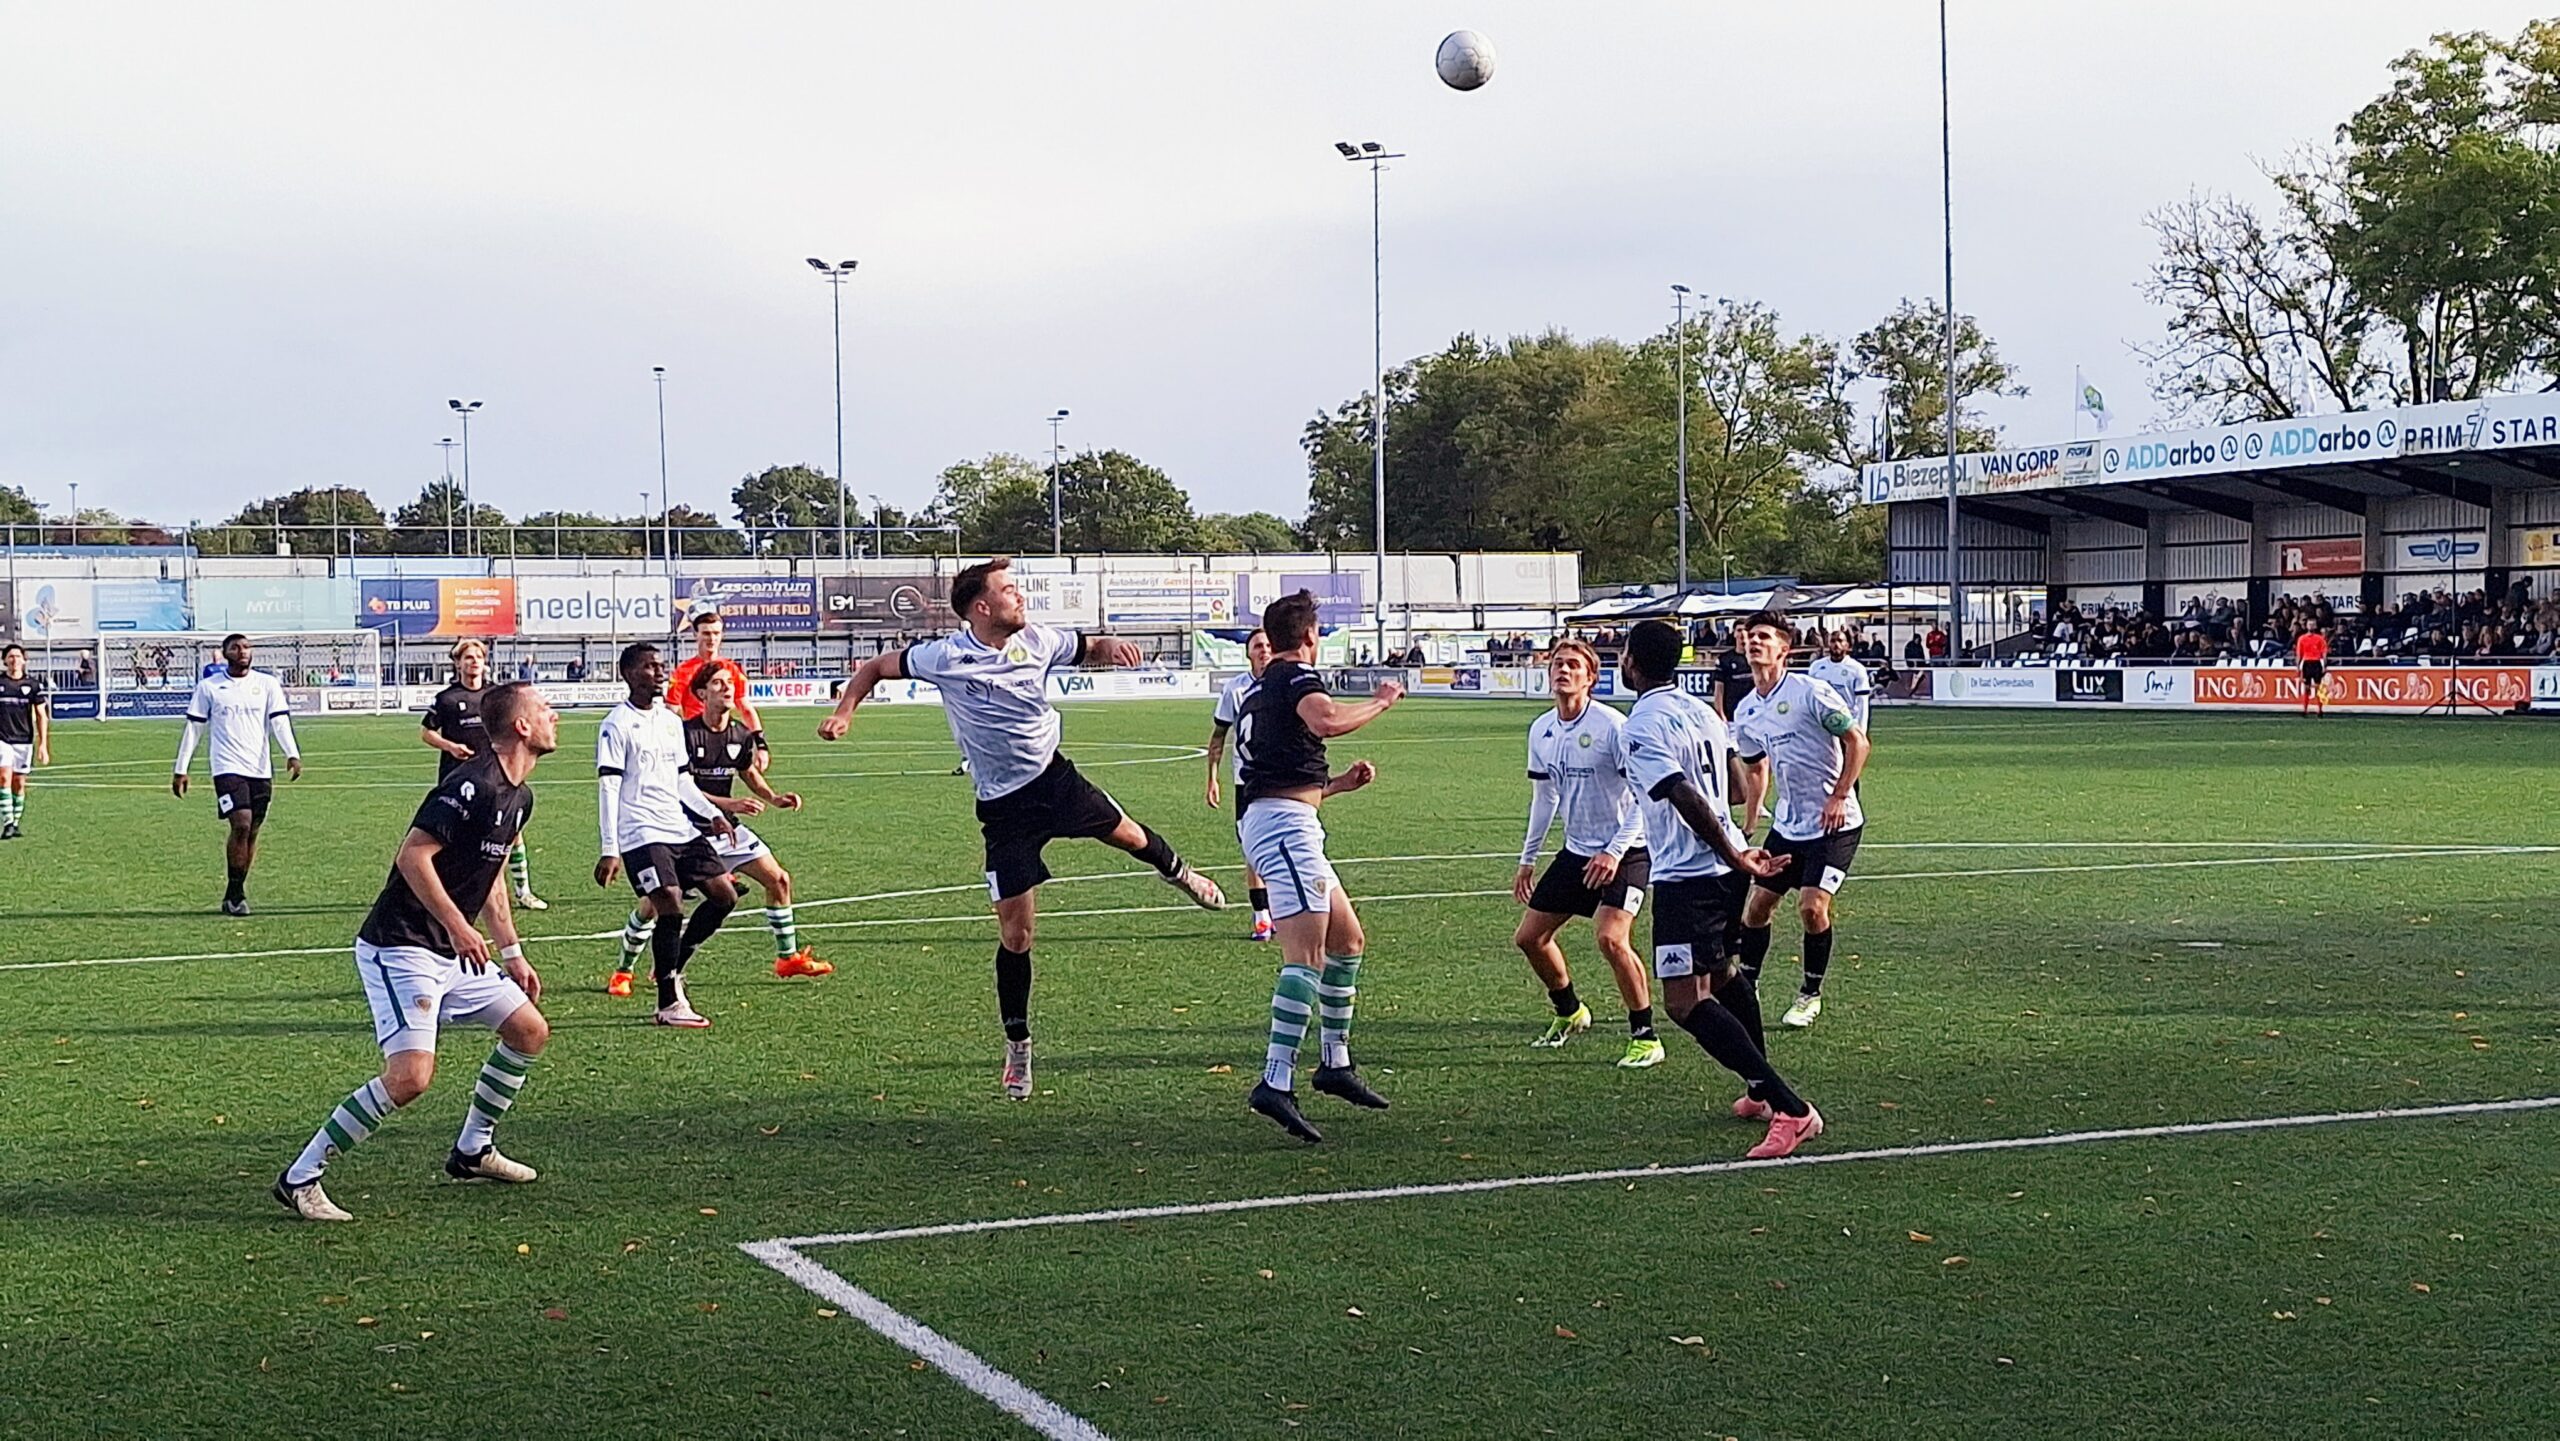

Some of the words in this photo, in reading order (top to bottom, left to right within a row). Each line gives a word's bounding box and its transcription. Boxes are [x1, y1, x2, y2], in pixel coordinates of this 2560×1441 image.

[2269, 424, 2371, 457] ADDarbo
[2404, 424, 2463, 452] PRIM
[1980, 453, 2013, 475] VAN
[2015, 448, 2060, 472] GORP
[2125, 439, 2216, 471] ADDarbo
[526, 590, 665, 619] neelevat
[1056, 675, 1094, 695] VSM
[2071, 670, 2106, 693] Lux
[2198, 676, 2238, 699] ING
[2356, 677, 2401, 701] ING
[2442, 677, 2491, 701] ING
